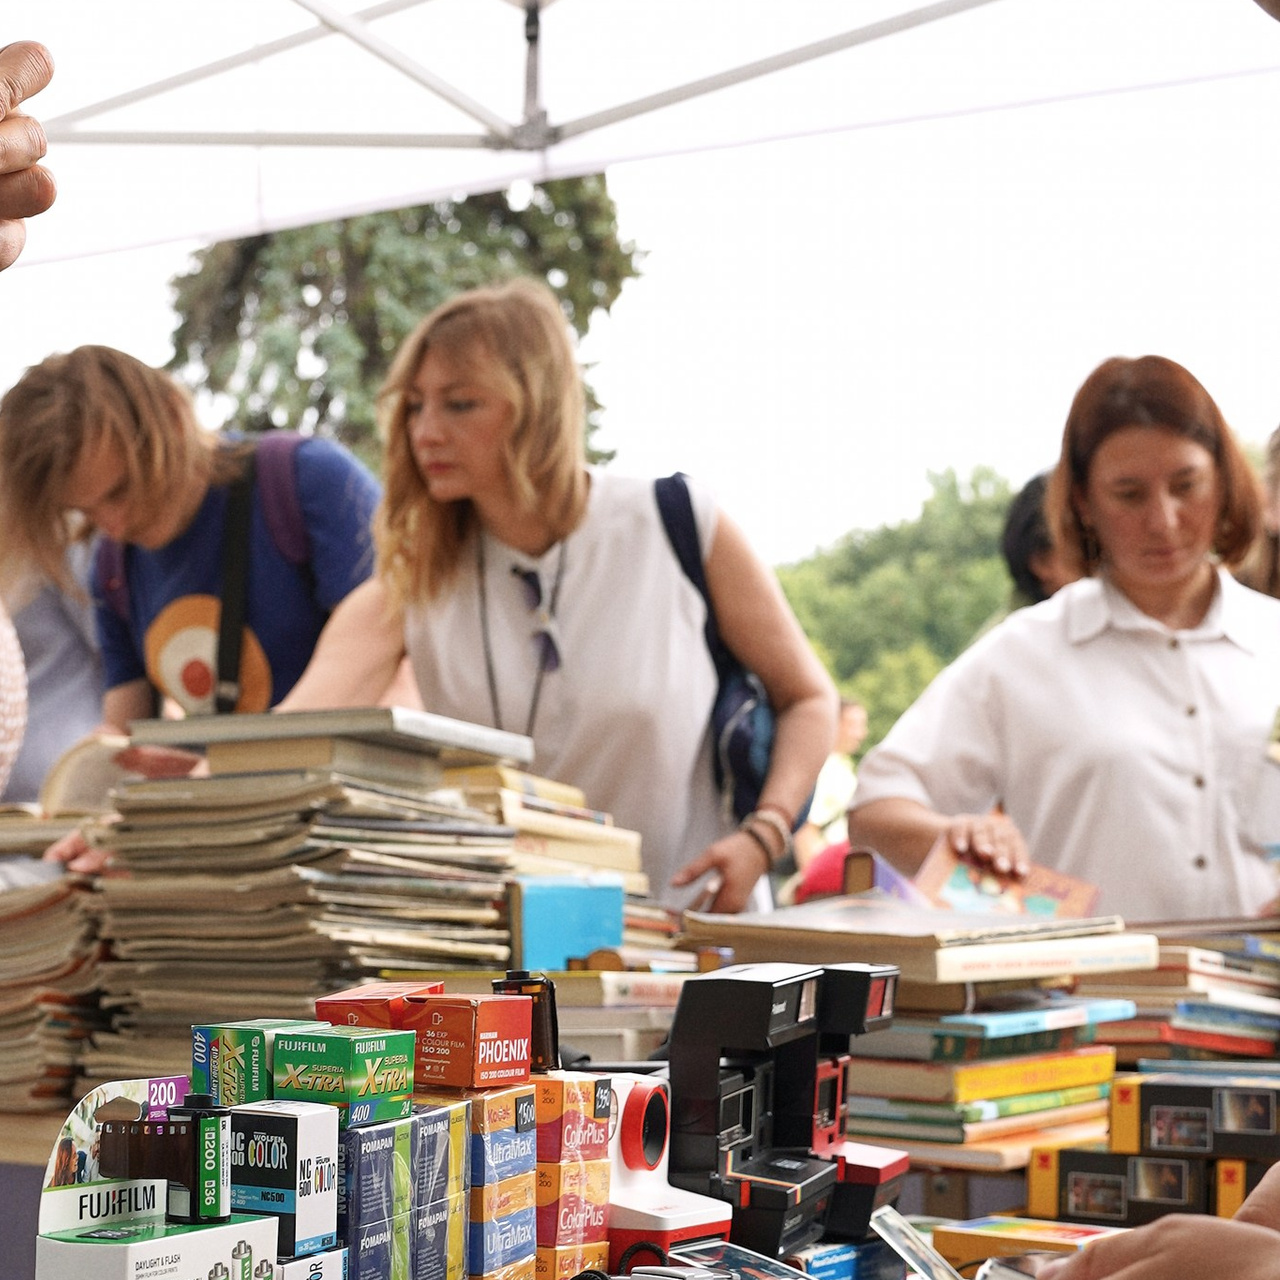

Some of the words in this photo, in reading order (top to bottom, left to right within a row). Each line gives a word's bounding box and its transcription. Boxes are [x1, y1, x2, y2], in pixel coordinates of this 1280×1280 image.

[194, 1032, 206, 1063] 400
[278, 1040, 326, 1053] FUJIFILM
[355, 1040, 386, 1054] FUJIFILM
[422, 1039, 449, 1047] COLOUR
[479, 1038, 528, 1064] PHOENIX
[312, 1064, 345, 1073] SUPERIA
[384, 1054, 408, 1065] SUPERIA
[278, 1064, 345, 1093] X-TRA
[358, 1058, 408, 1096] X-TRA
[488, 1071, 497, 1079] 200
[498, 1069, 514, 1078] COLOUR
[515, 1068, 525, 1076] FILM
[150, 1082, 176, 1106] 200
[351, 1105, 370, 1121] 400
[401, 1102, 410, 1114] 24
[488, 1105, 511, 1123] Kodak
[420, 1120, 448, 1137] FOMAPAN
[564, 1123, 605, 1148] ColorPlus
[362, 1136, 393, 1154] FOMAPAN
[205, 1140, 216, 1170] 200
[248, 1140, 288, 1169] COLOR
[300, 1158, 311, 1180] NC
[314, 1163, 336, 1194] COLOR
[205, 1188, 216, 1206] 36
[261, 1191, 284, 1202] NC500
[299, 1180, 311, 1197] 500
[79, 1185, 156, 1220] FUJIFILM
[418, 1210, 447, 1229] FOMAPAN
[560, 1209, 604, 1230] ColorPlus
[361, 1232, 391, 1250] FOMAPAN
[487, 1224, 532, 1254] UltraMax
[135, 1257, 160, 1271] DAYLIGHT
[165, 1254, 181, 1265] FLASH
